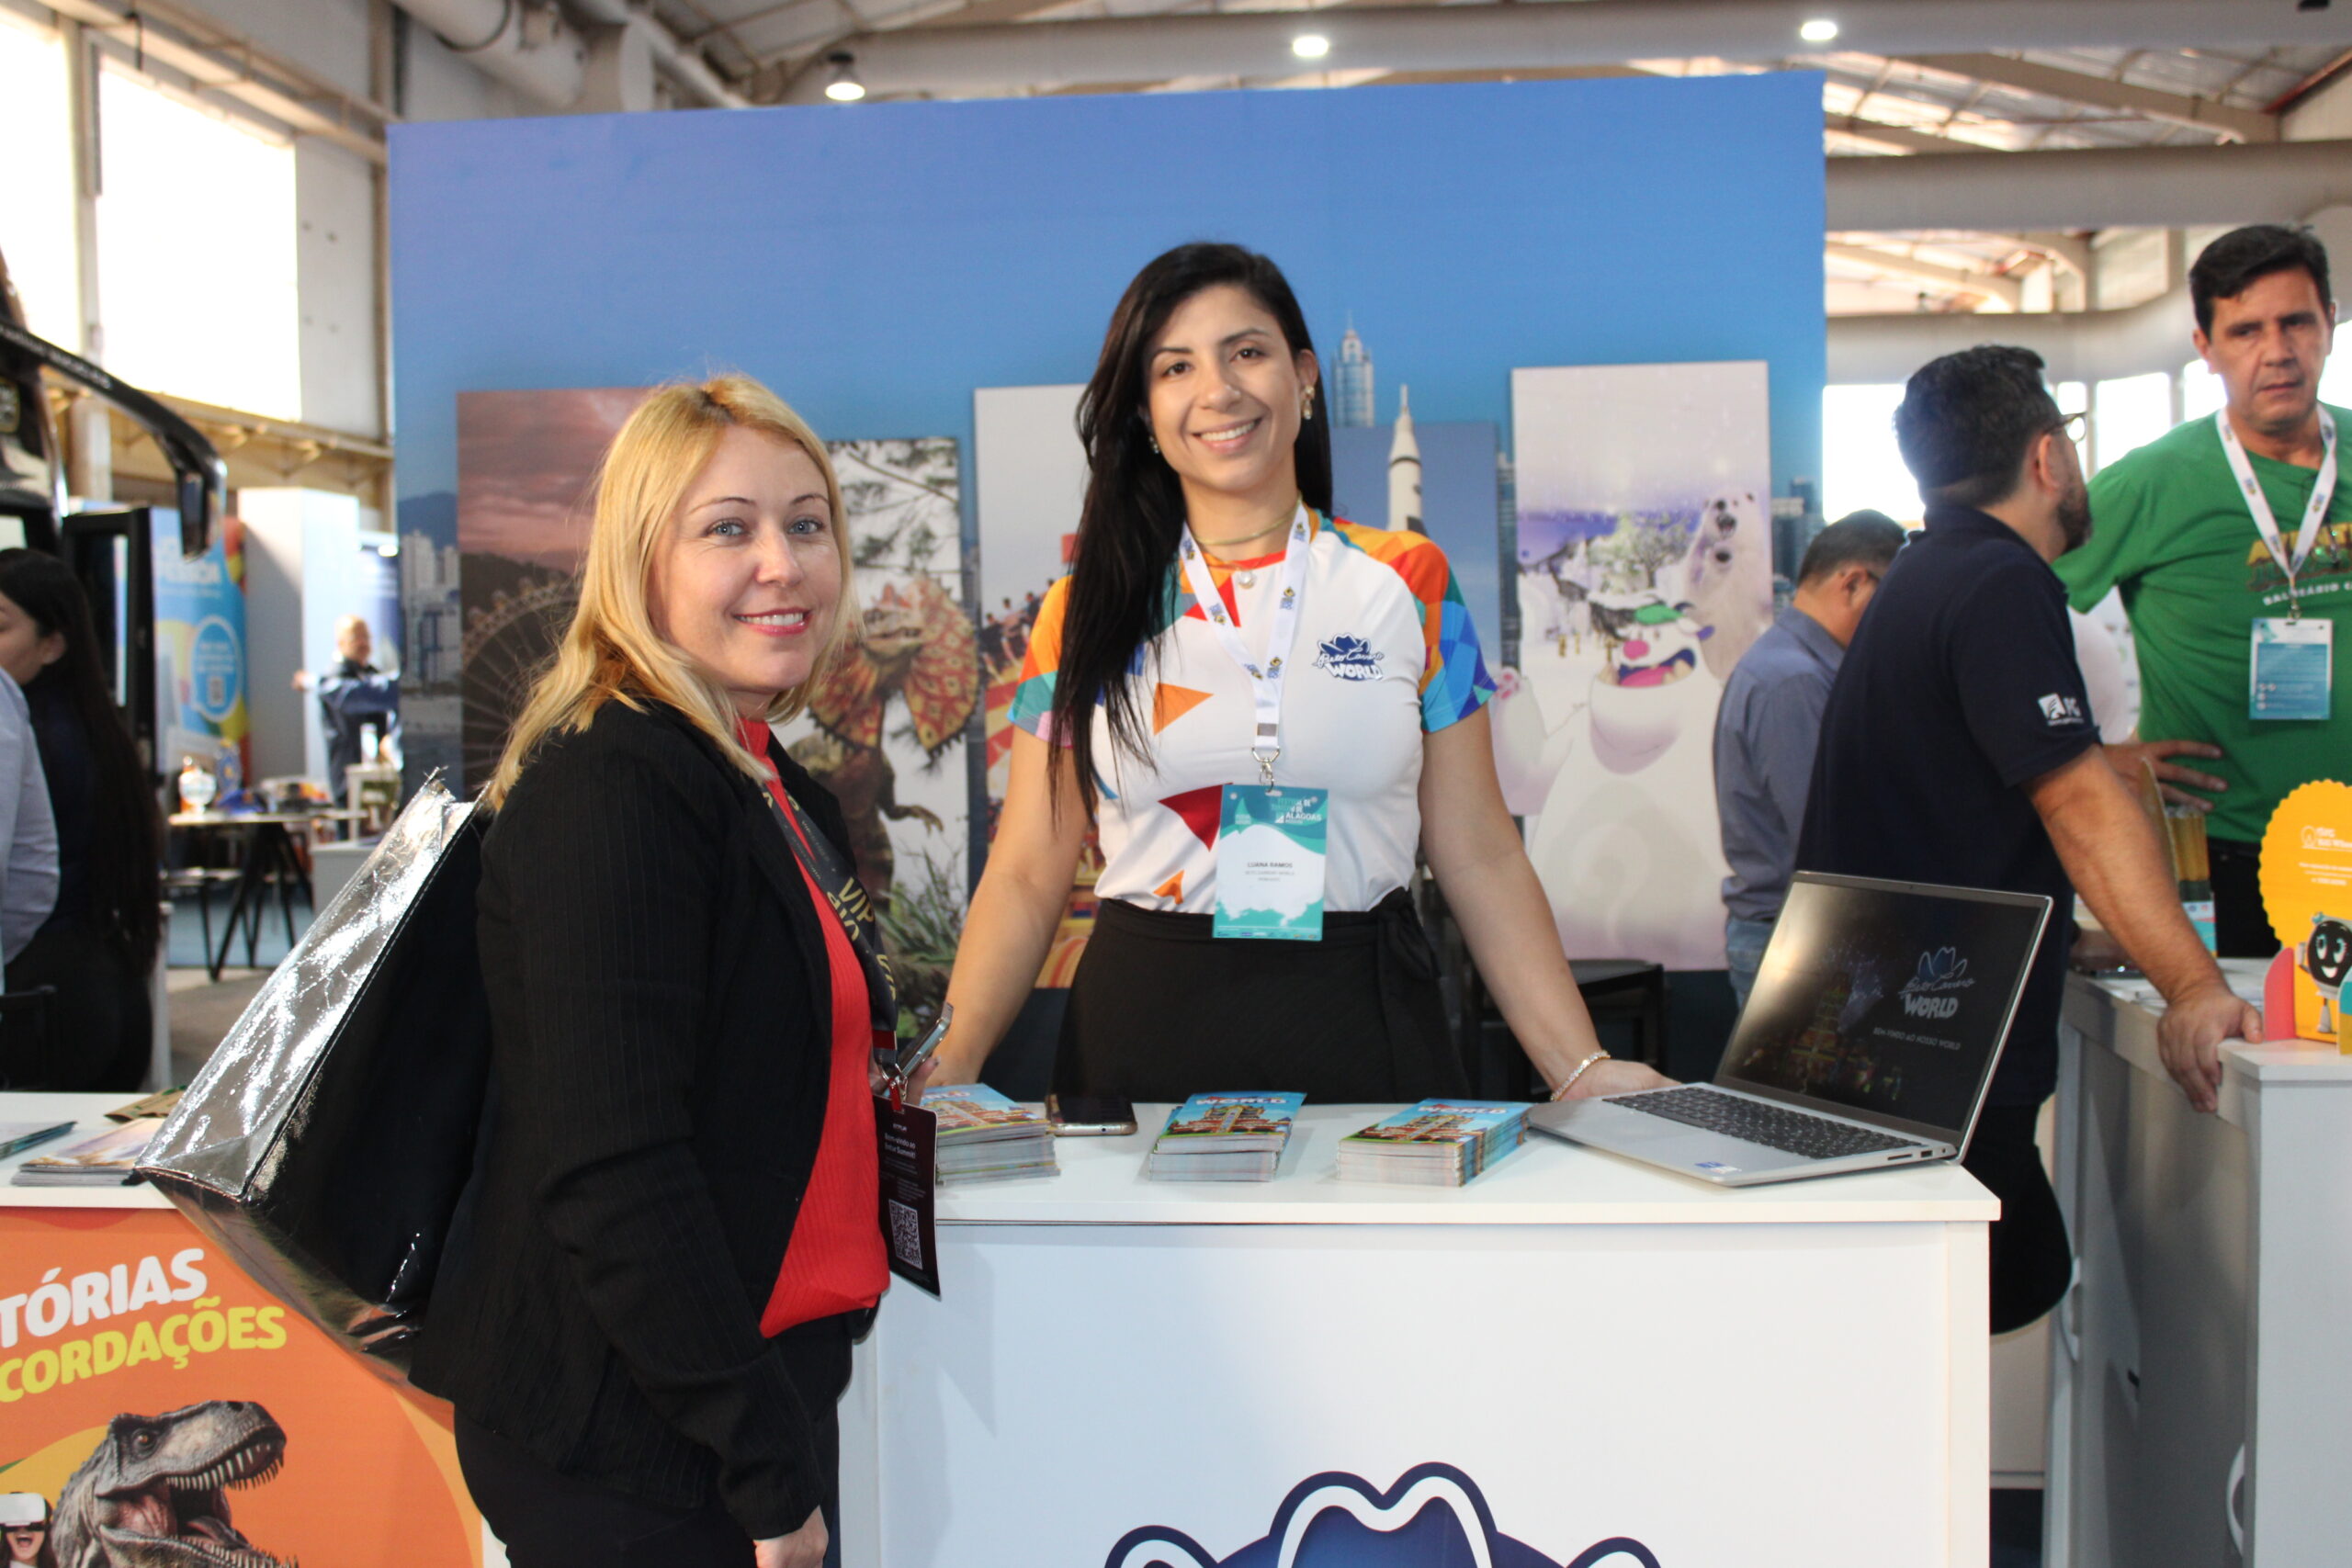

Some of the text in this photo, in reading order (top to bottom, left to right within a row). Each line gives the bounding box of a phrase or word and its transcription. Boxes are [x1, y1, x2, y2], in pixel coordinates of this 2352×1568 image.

[1324, 662, 1383, 680] WORLD
[839, 876, 876, 922] VIP
[1905, 993, 1959, 1020] WORLD
[0, 1248, 208, 1348] TÓRIAS
[0, 1296, 287, 1402] CORDAÇÕES
